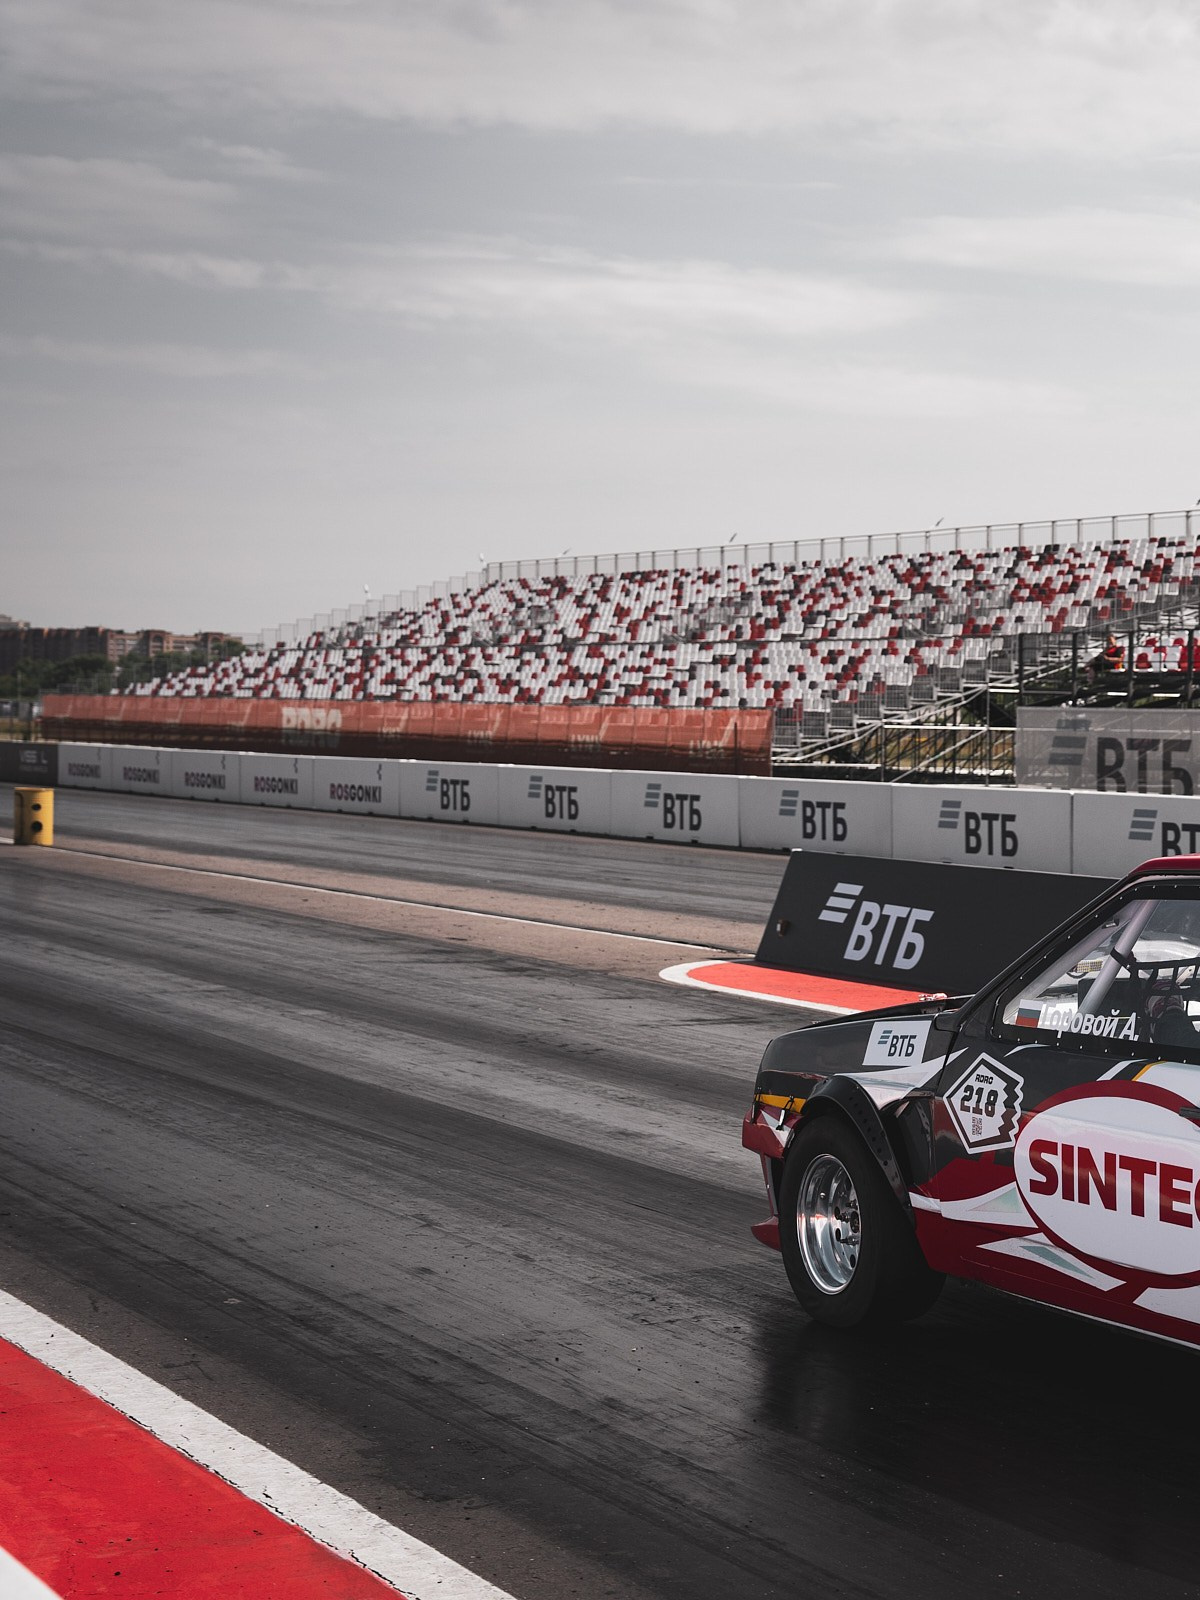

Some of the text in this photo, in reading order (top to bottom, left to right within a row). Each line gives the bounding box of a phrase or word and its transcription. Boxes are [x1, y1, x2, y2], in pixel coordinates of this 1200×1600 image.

[184, 771, 226, 790] ROSGONKI
[1097, 737, 1194, 796] ВТБ
[254, 776, 298, 795] ROSGONKI
[329, 783, 382, 803] ROSGONKI
[440, 778, 470, 811] ВТБ
[544, 785, 579, 820] ВТБ
[662, 792, 701, 831] ВТБ
[802, 801, 847, 842] ВТБ
[964, 811, 1018, 855] ВТБ
[843, 901, 934, 970] ВТБ
[888, 1033, 916, 1057] ВТБ
[960, 1085, 998, 1117] 218
